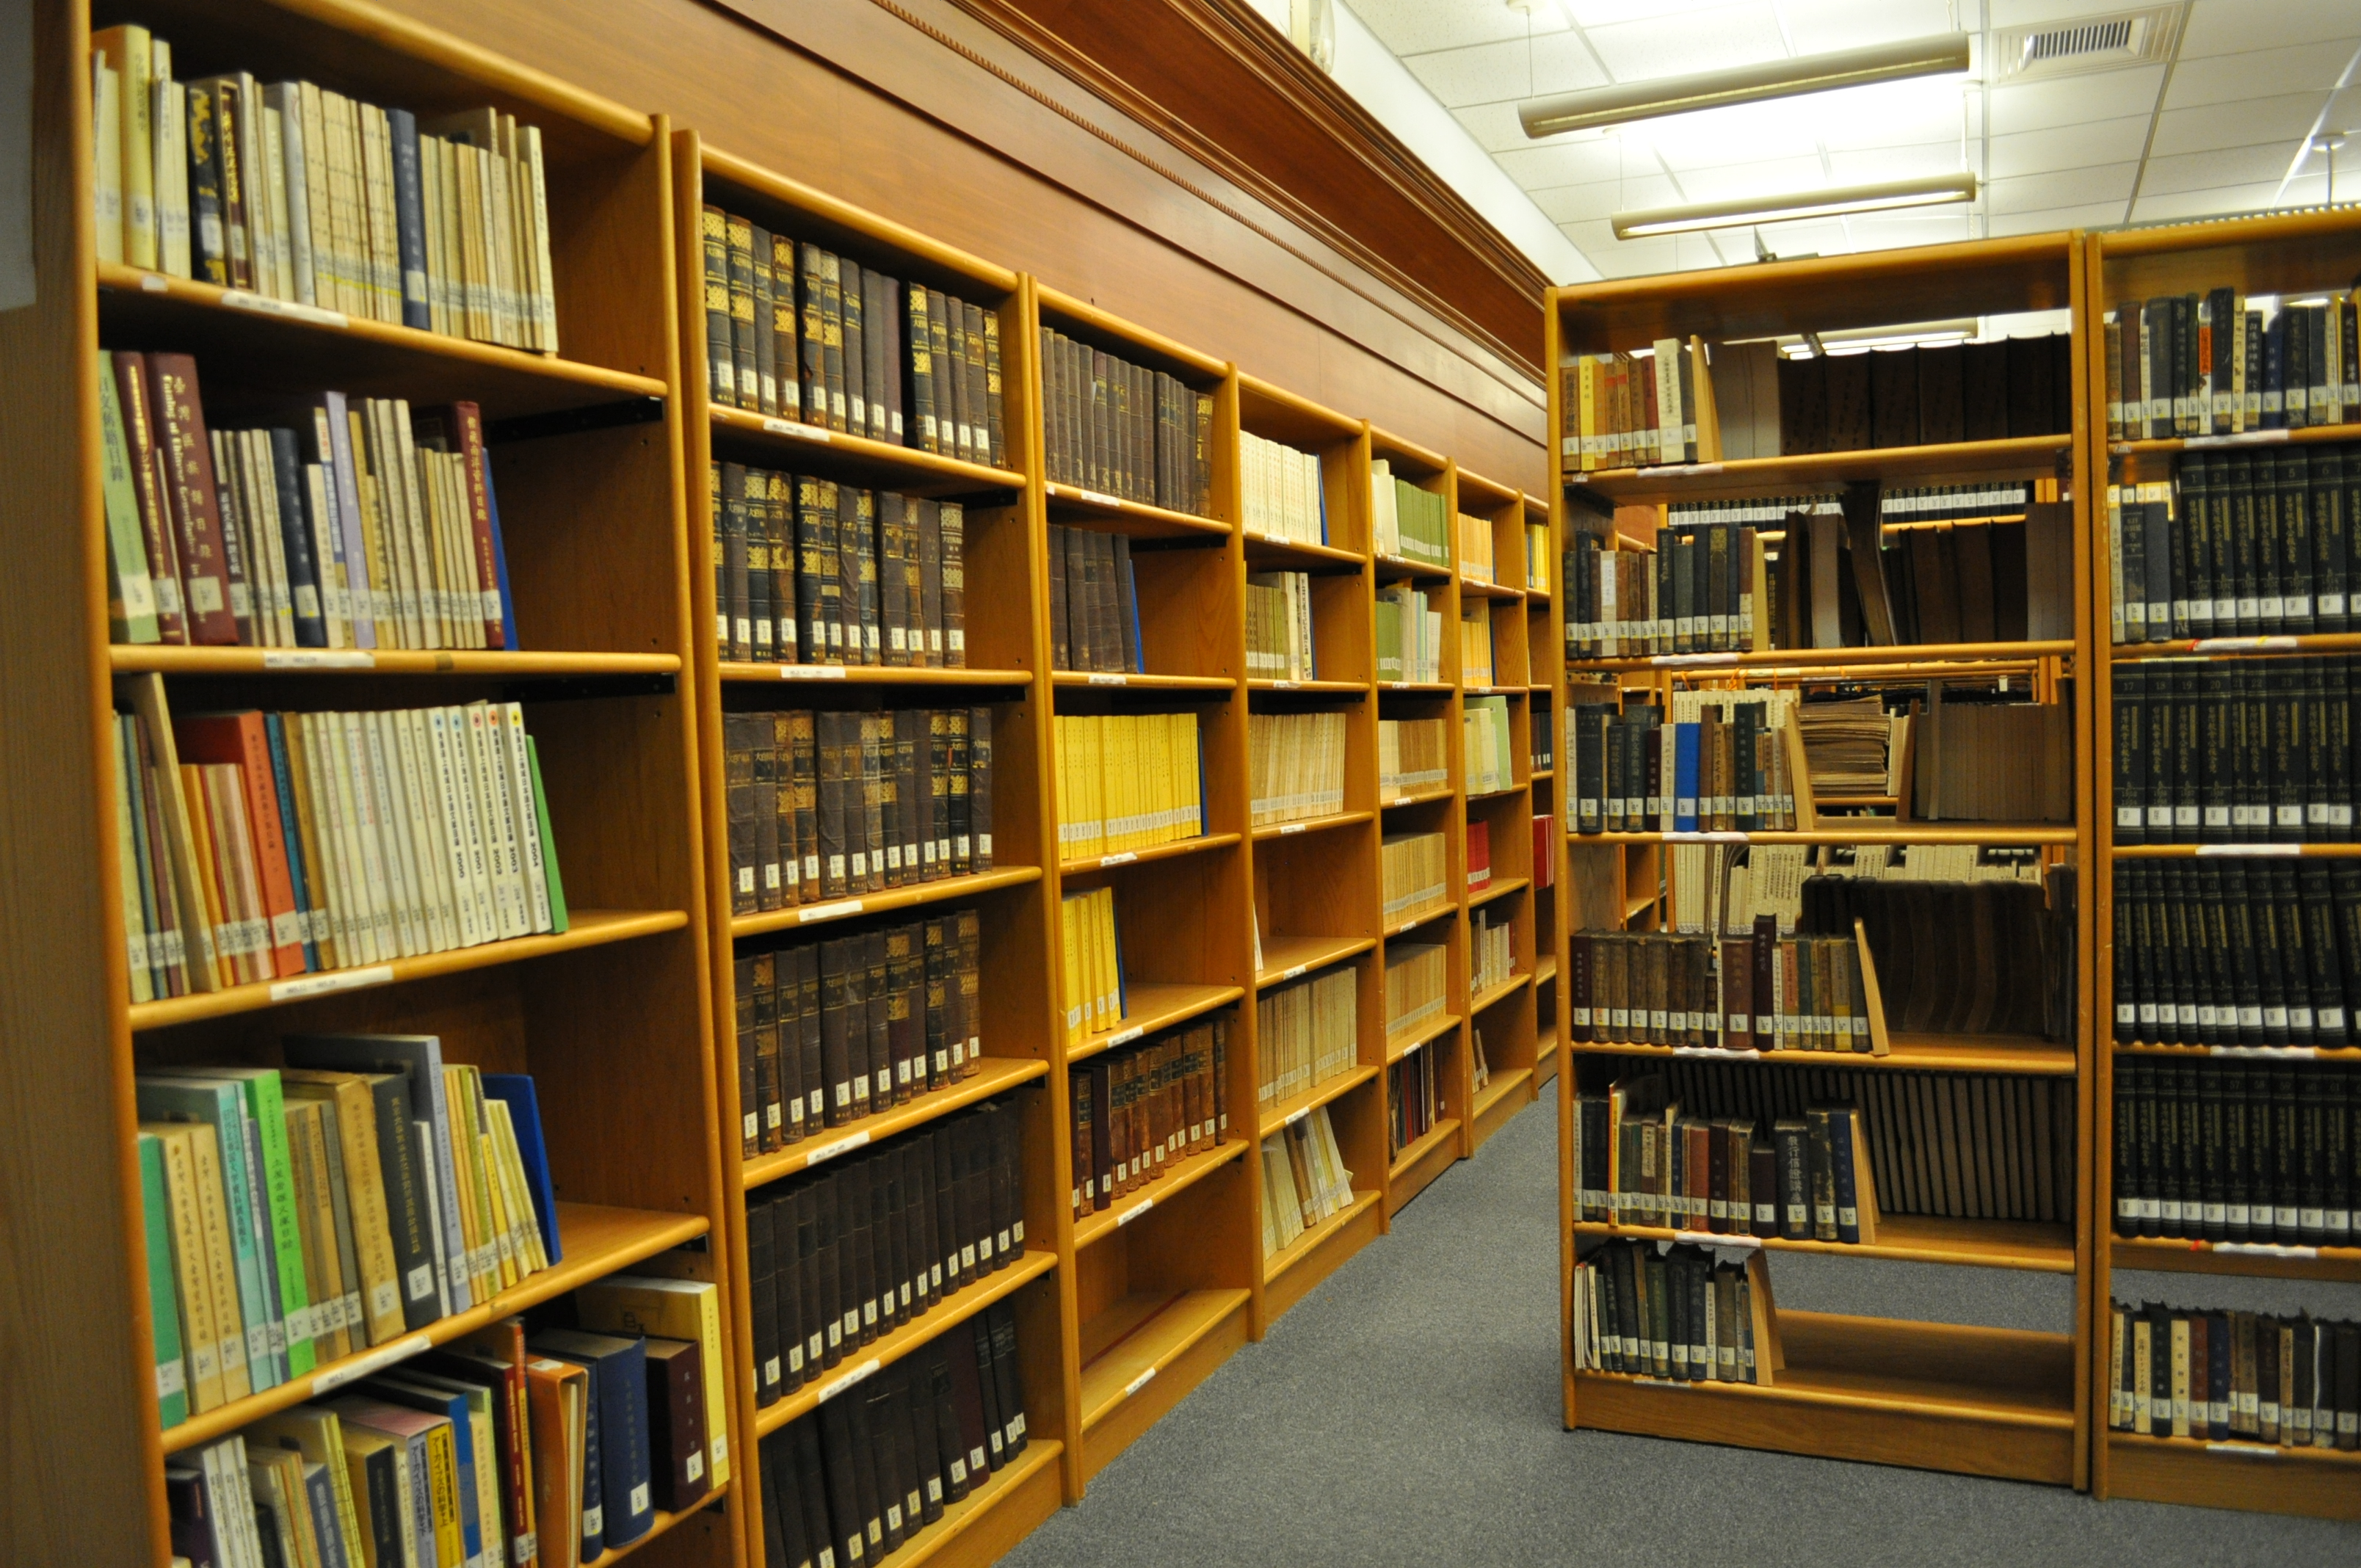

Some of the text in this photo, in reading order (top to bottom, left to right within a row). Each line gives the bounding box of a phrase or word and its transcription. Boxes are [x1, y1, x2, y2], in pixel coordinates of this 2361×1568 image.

[455, 852, 465, 878] 2000
[474, 850, 483, 874] 2001
[493, 849, 502, 876] 2002
[509, 846, 518, 873] 2003
[531, 842, 539, 867] 2004
